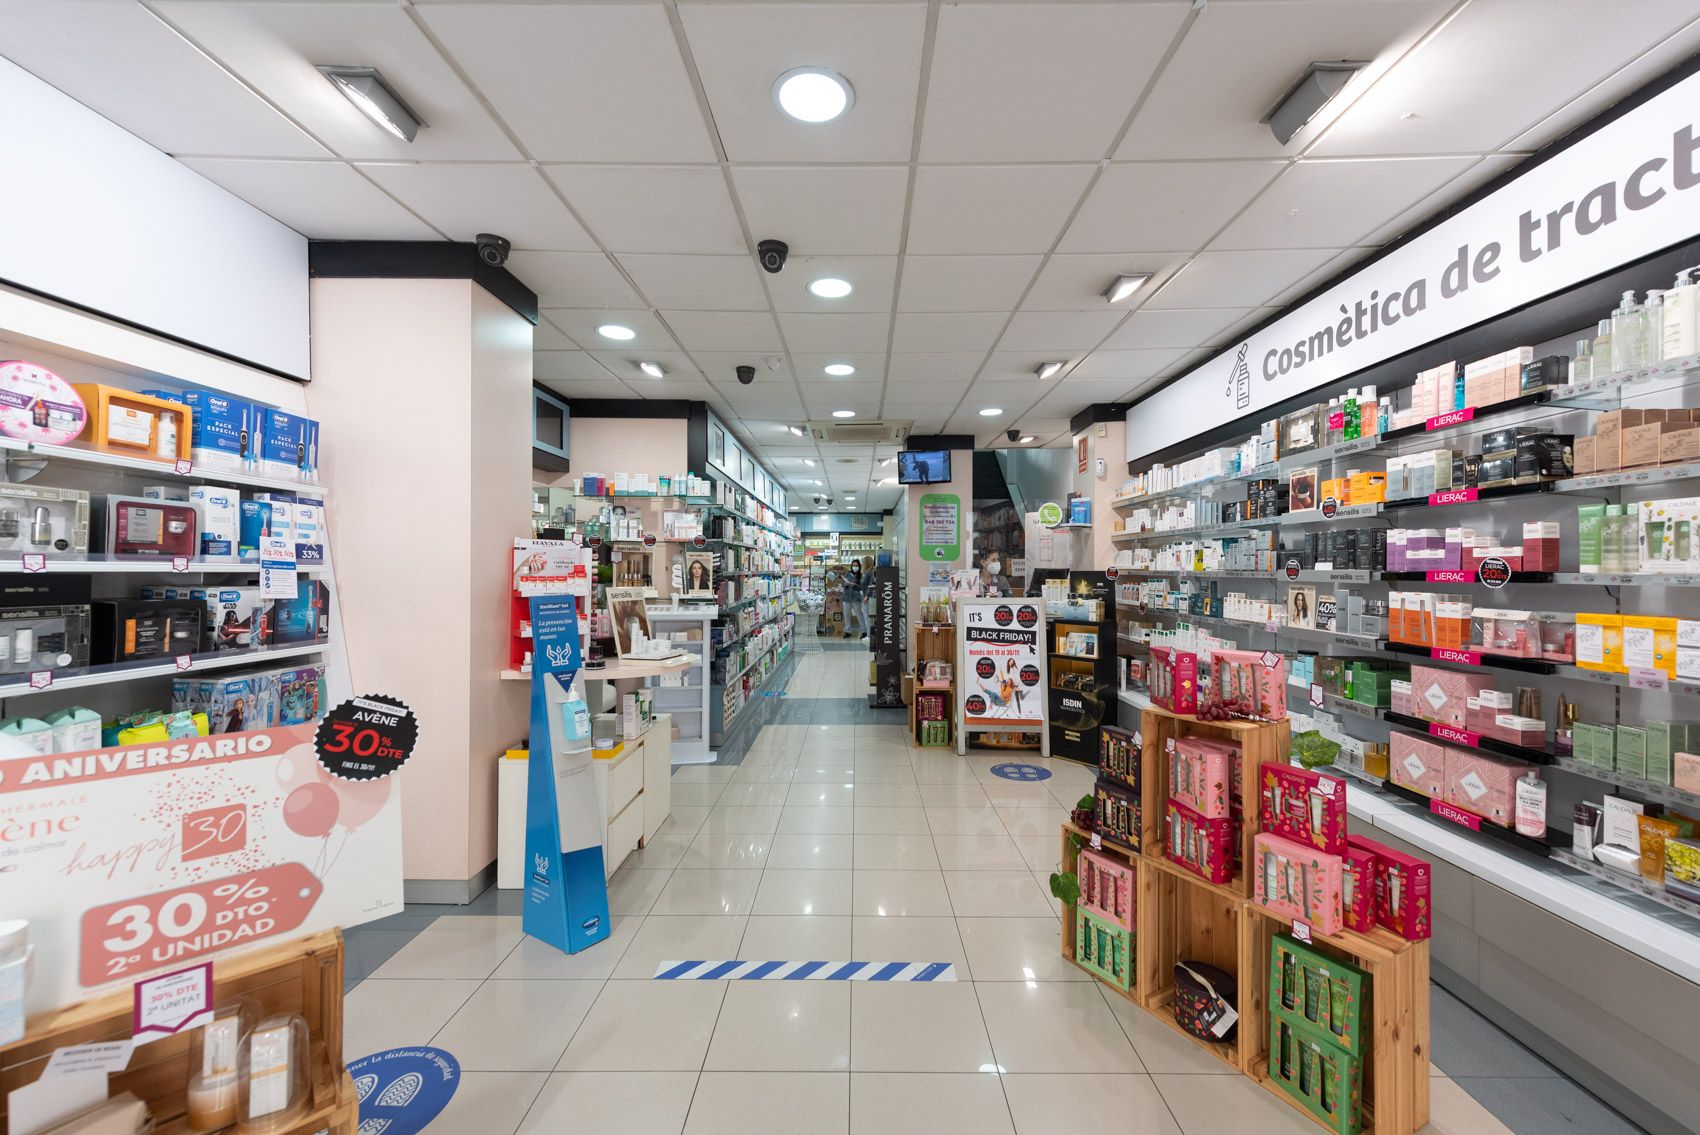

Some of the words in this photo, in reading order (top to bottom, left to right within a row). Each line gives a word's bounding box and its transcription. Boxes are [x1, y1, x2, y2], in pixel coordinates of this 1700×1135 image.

[1262, 277, 1427, 382] Cosmètica
[1440, 242, 1501, 299] de
[1518, 123, 1700, 263] tract
[215, 421, 232, 429] PACK
[1434, 412, 1463, 427] LIERAC
[207, 425, 239, 437] ESPECIAL
[271, 439, 297, 449] ESPECIAL
[1334, 444, 1359, 454] sensilis
[1437, 492, 1467, 504] LIERAC
[1336, 507, 1360, 516] sensilis
[301, 550, 319, 559] 33%
[1435, 572, 1465, 581] LIERAC
[1483, 569, 1497, 578] 20
[611, 591, 632, 599] sensilis
[1319, 603, 1337, 614] 40%
[969, 613, 982, 622] IT'S
[995, 612, 1006, 620] 20
[1017, 612, 1028, 620] 20
[971, 630, 998, 640] BLACK
[1000, 633, 1032, 642] FRIDAY!
[1336, 637, 1359, 646] sensilis
[1439, 651, 1470, 662] LIERAC
[977, 665, 987, 673] 20
[1021, 672, 1032, 680] 20
[966, 702, 979, 710] 40
[1063, 698, 1082, 709] ISDIN
[1335, 701, 1358, 712] sensilis
[352, 711, 399, 727] AVÈNE
[323, 723, 380, 756] 30
[1438, 728, 1468, 743] LIERAC
[381, 736, 392, 747] %
[376, 747, 404, 759] DTE
[20, 734, 273, 784] ANIVERSARIO
[1438, 806, 1469, 825] LIERAC
[58, 832, 181, 880] happy
[212, 879, 270, 905] %
[102, 892, 208, 953] 30
[152, 918, 276, 962] UNIDAD
[150, 991, 173, 1003] 30%
[176, 983, 199, 996] DTE
[161, 993, 202, 1012] UNITAT
[384, 1049, 425, 1060] distancia
